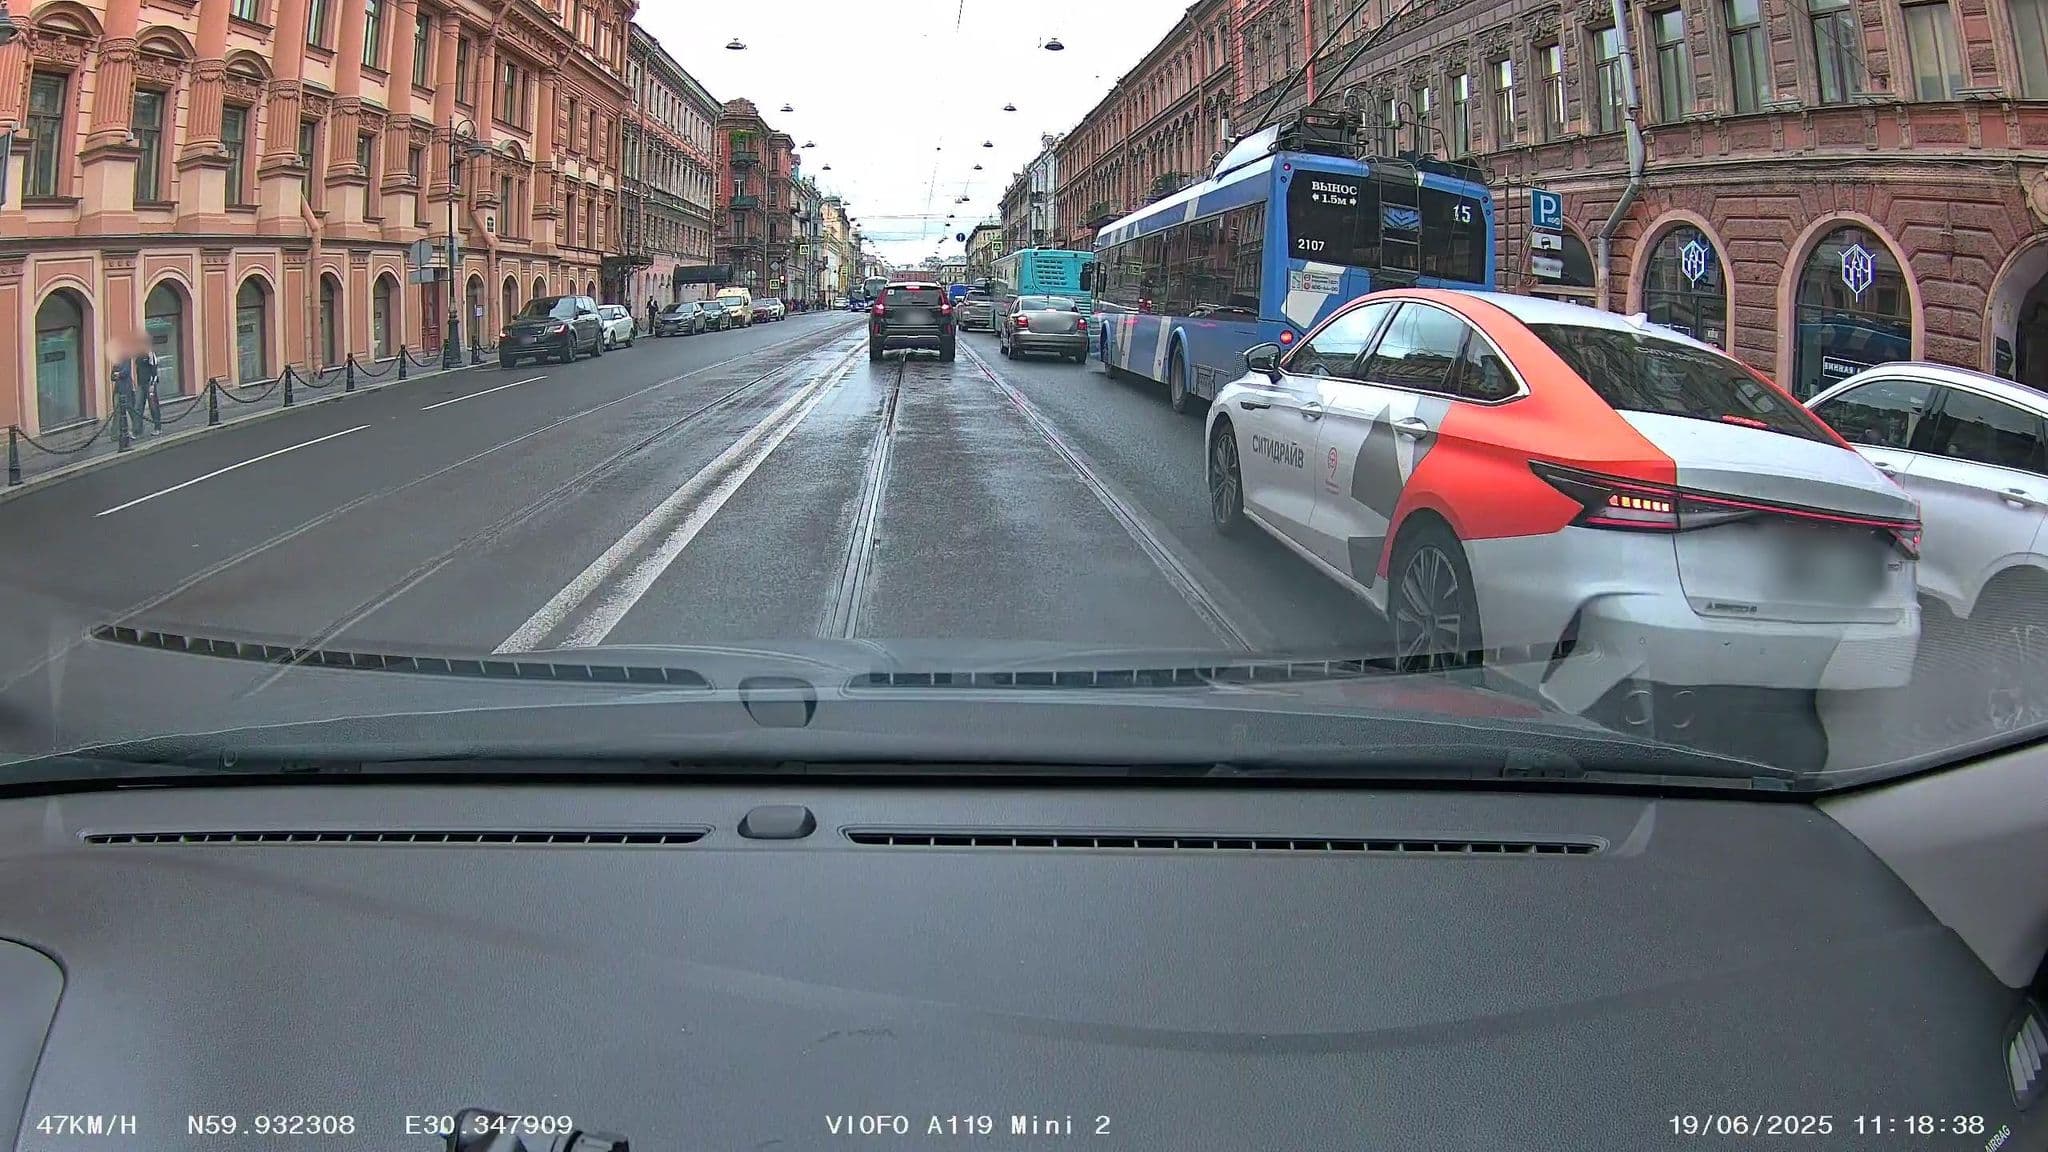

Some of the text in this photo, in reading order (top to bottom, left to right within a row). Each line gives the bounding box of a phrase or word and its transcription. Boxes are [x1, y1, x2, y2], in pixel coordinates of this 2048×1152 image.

[1311, 181, 1358, 196] ВЫНОС
[1453, 203, 1472, 223] 15
[1540, 194, 1557, 224] P
[1298, 238, 1325, 252] 2107
[1252, 434, 1304, 469] СИТИДРАЙВ
[1984, 1124, 2011, 1152] AIRBAG
